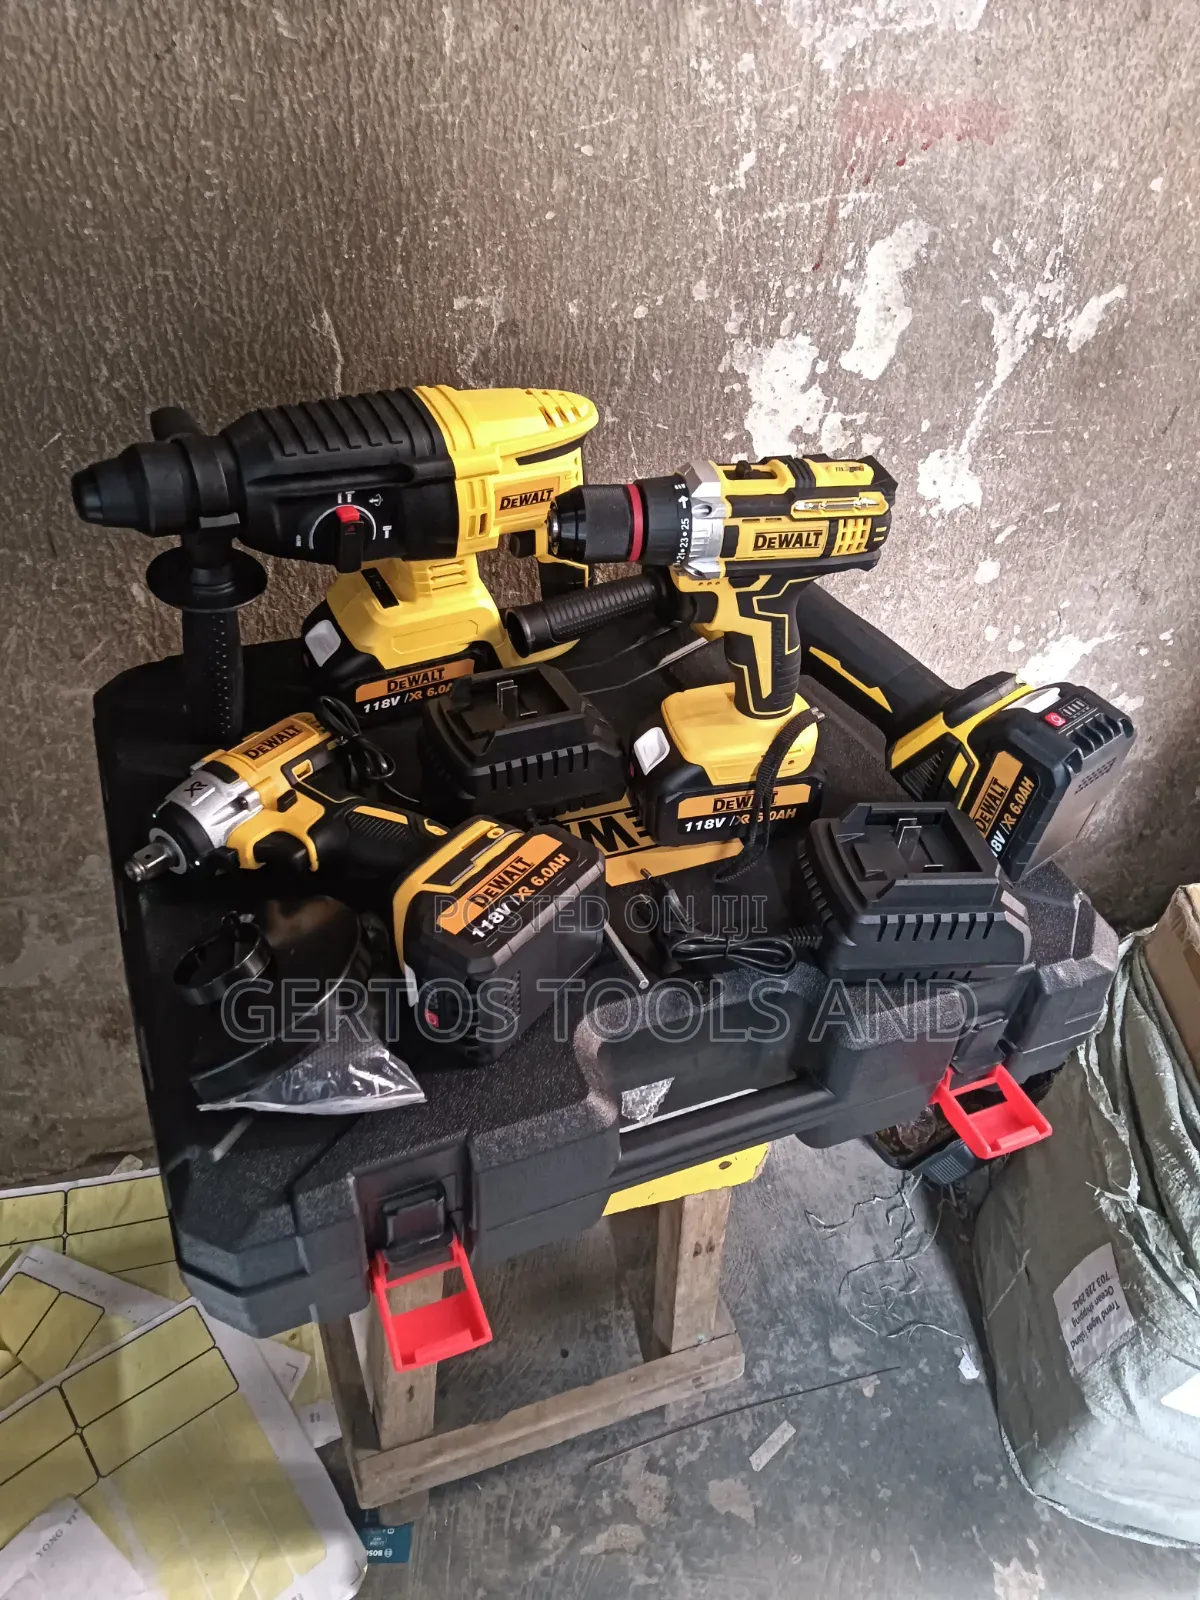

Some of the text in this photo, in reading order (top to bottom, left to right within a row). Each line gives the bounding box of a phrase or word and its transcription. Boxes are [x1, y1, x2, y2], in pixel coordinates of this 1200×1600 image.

[499, 488, 554, 511] DEWALT
[681, 517, 690, 530] 25
[679, 537, 689, 549] 23
[752, 530, 823, 551] DEWALT
[387, 667, 445, 694] DEWALT
[363, 696, 401, 713] 118V
[242, 725, 302, 760] DEWALT
[184, 781, 208, 798] XR
[1009, 775, 1036, 815] 6.0AH
[685, 817, 726, 832] 118V
[469, 855, 535, 909] DEWALT
[472, 902, 512, 938] 118V
[530, 853, 571, 887] 6.0AH
[1096, 1271, 1111, 1287] 703
[1071, 1285, 1115, 1328] Ocean shipping
[1101, 1300, 1121, 1320] Trend
